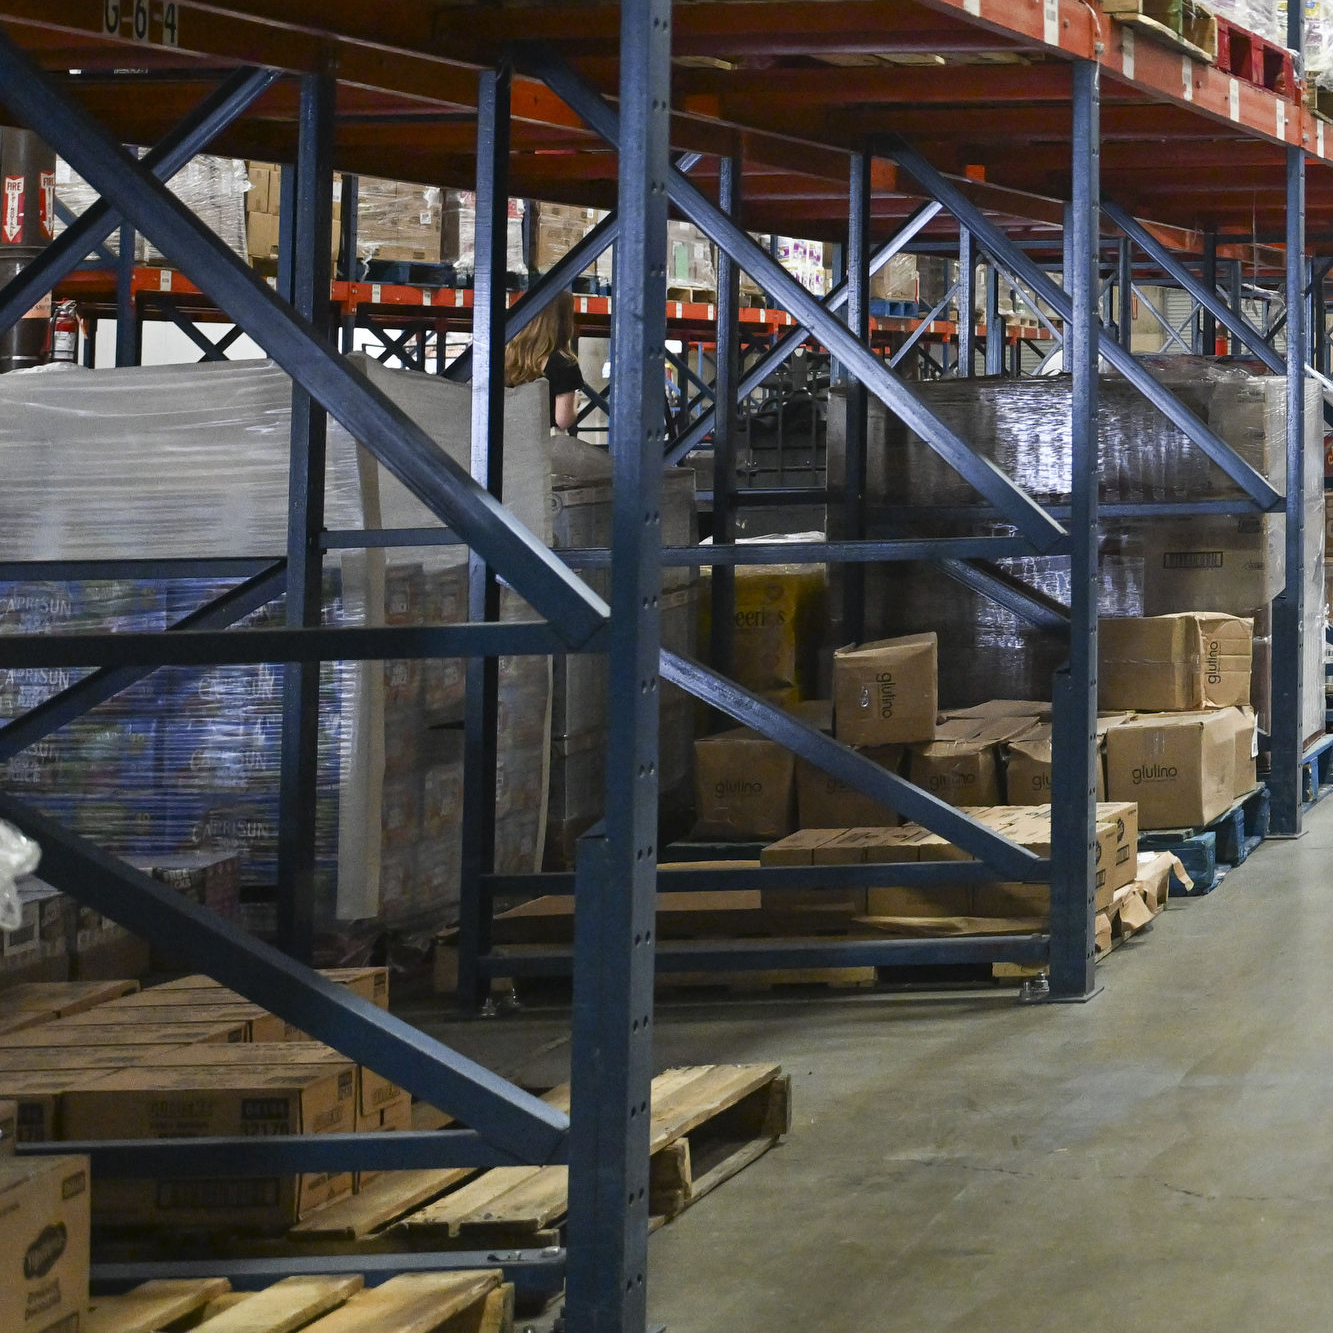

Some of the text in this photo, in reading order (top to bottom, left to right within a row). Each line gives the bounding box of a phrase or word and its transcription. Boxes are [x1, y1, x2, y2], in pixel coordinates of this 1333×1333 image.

[7, 182, 22, 192] FIRE
[876, 671, 897, 719] glutino
[1131, 764, 1179, 785] glutino
[714, 780, 762, 799] glutino
